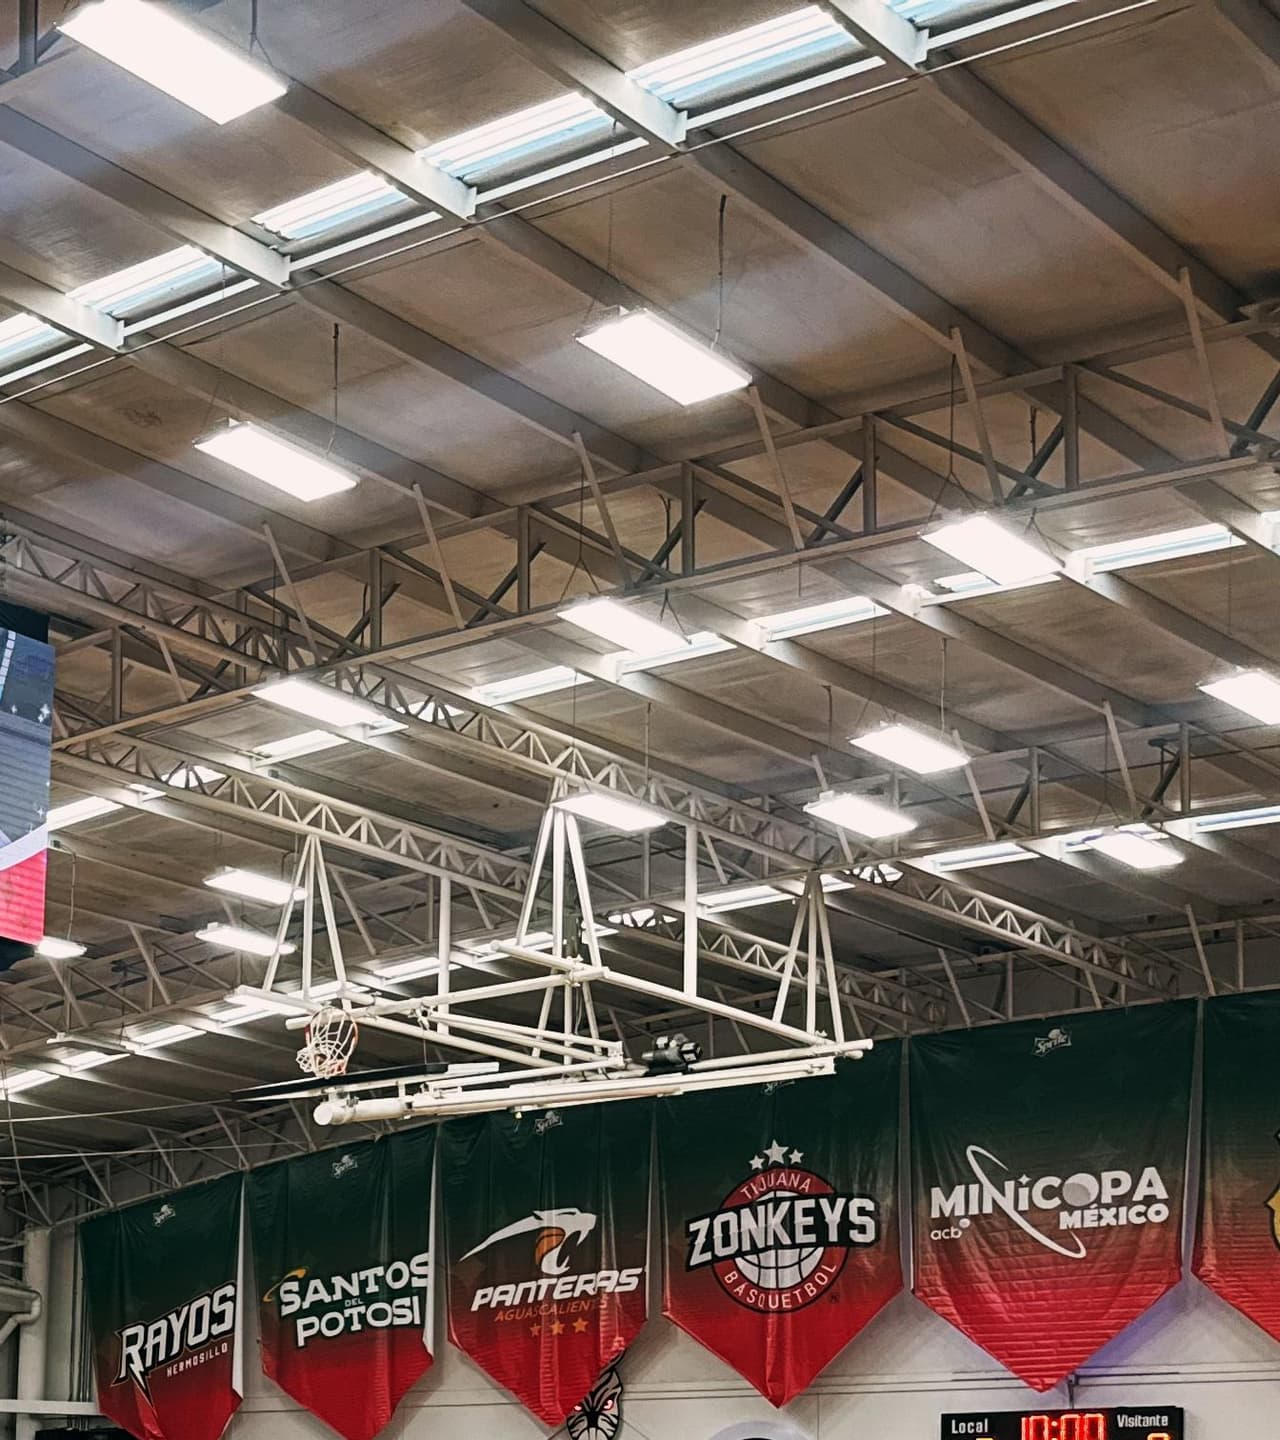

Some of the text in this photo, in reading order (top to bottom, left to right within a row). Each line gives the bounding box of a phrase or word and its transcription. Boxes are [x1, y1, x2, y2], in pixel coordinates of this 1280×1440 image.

[741, 1172, 812, 1200] TIJUANA
[689, 1197, 876, 1266] ZONKEYS
[930, 1221, 967, 1240] acb
[1059, 1203, 1169, 1230] MÉXICO
[279, 1252, 430, 1317] SANTOS
[345, 1298, 363, 1306] DEL
[471, 1267, 643, 1311] PANTERAS
[724, 1263, 837, 1309] BASQUETBOL
[117, 1284, 236, 1380] RAYOS
[296, 1295, 420, 1348] POTOSI
[166, 1342, 228, 1377] HERMOSILLO
[951, 1418, 989, 1434] Local
[1117, 1414, 1168, 1428] Visitante
